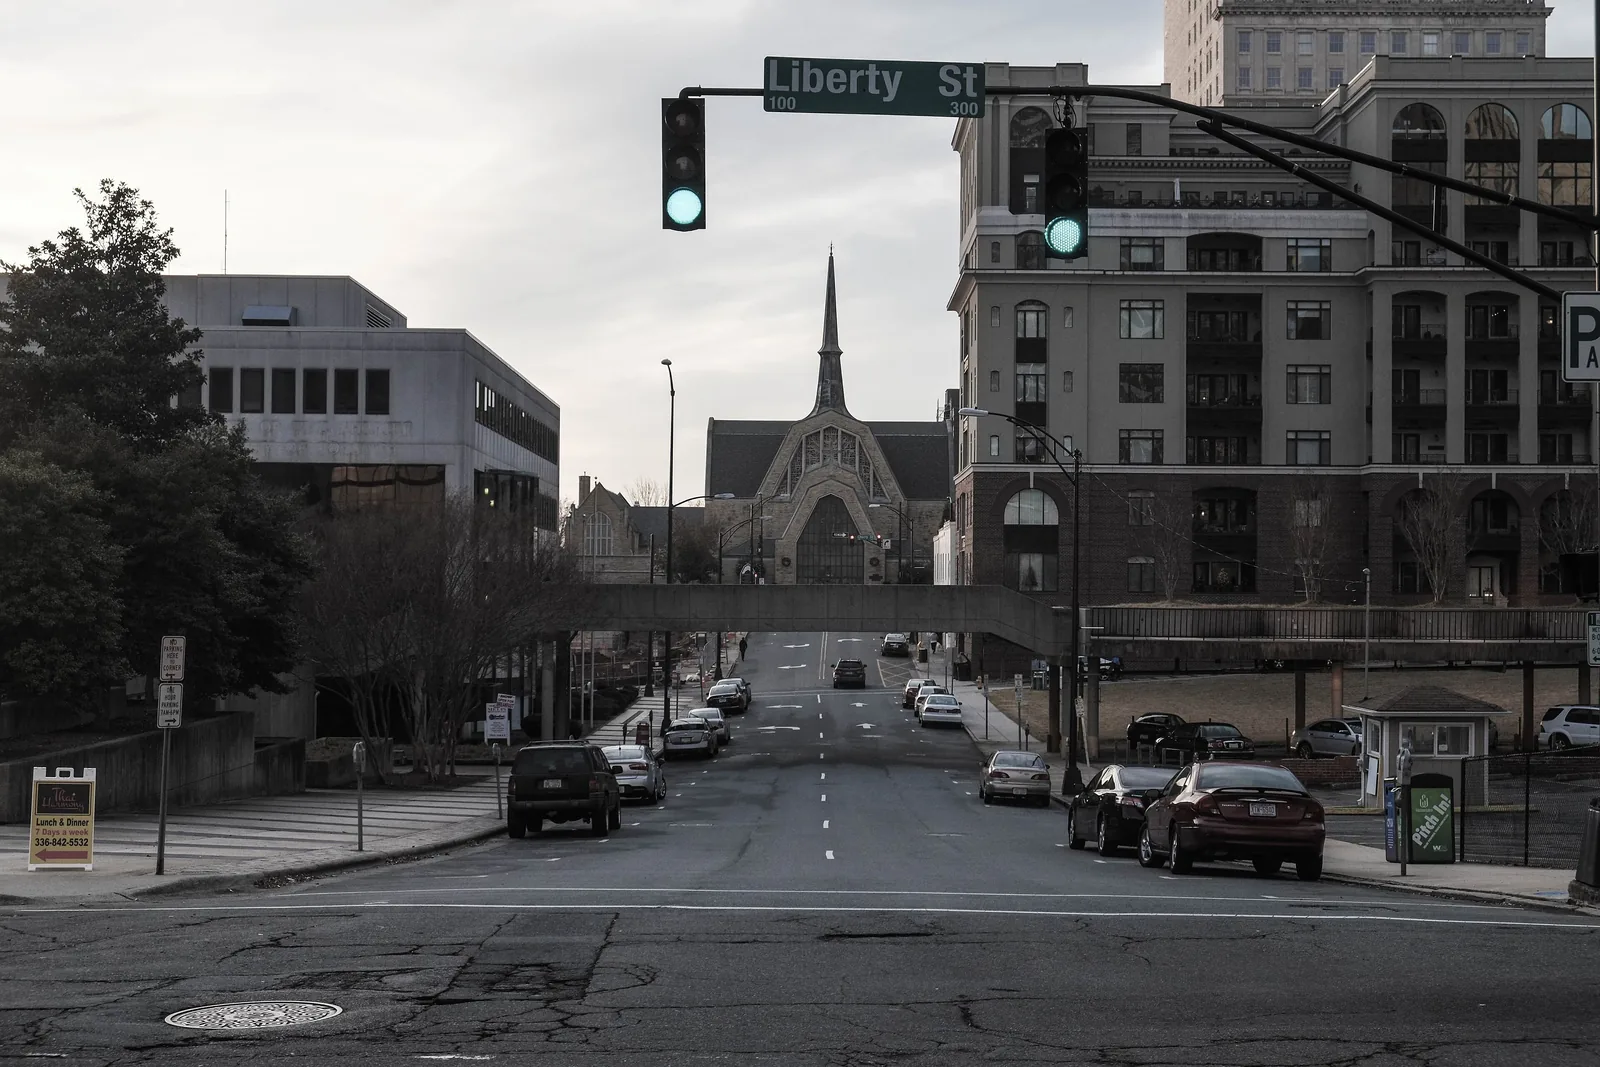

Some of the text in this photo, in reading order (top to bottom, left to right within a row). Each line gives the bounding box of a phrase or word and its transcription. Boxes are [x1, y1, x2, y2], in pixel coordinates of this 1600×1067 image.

[769, 59, 978, 102] Liberty St
[769, 96, 979, 116] 100 300
[51, 787, 77, 802] Thai
[41, 797, 85, 812] Harmony
[36, 818, 89, 826] Lunch & Dinner
[1411, 815, 1440, 847] Pitch
[1432, 793, 1452, 816] In!
[35, 828, 41, 836] 7
[42, 828, 60, 838] Days
[35, 838, 89, 846] 336-842-5532
